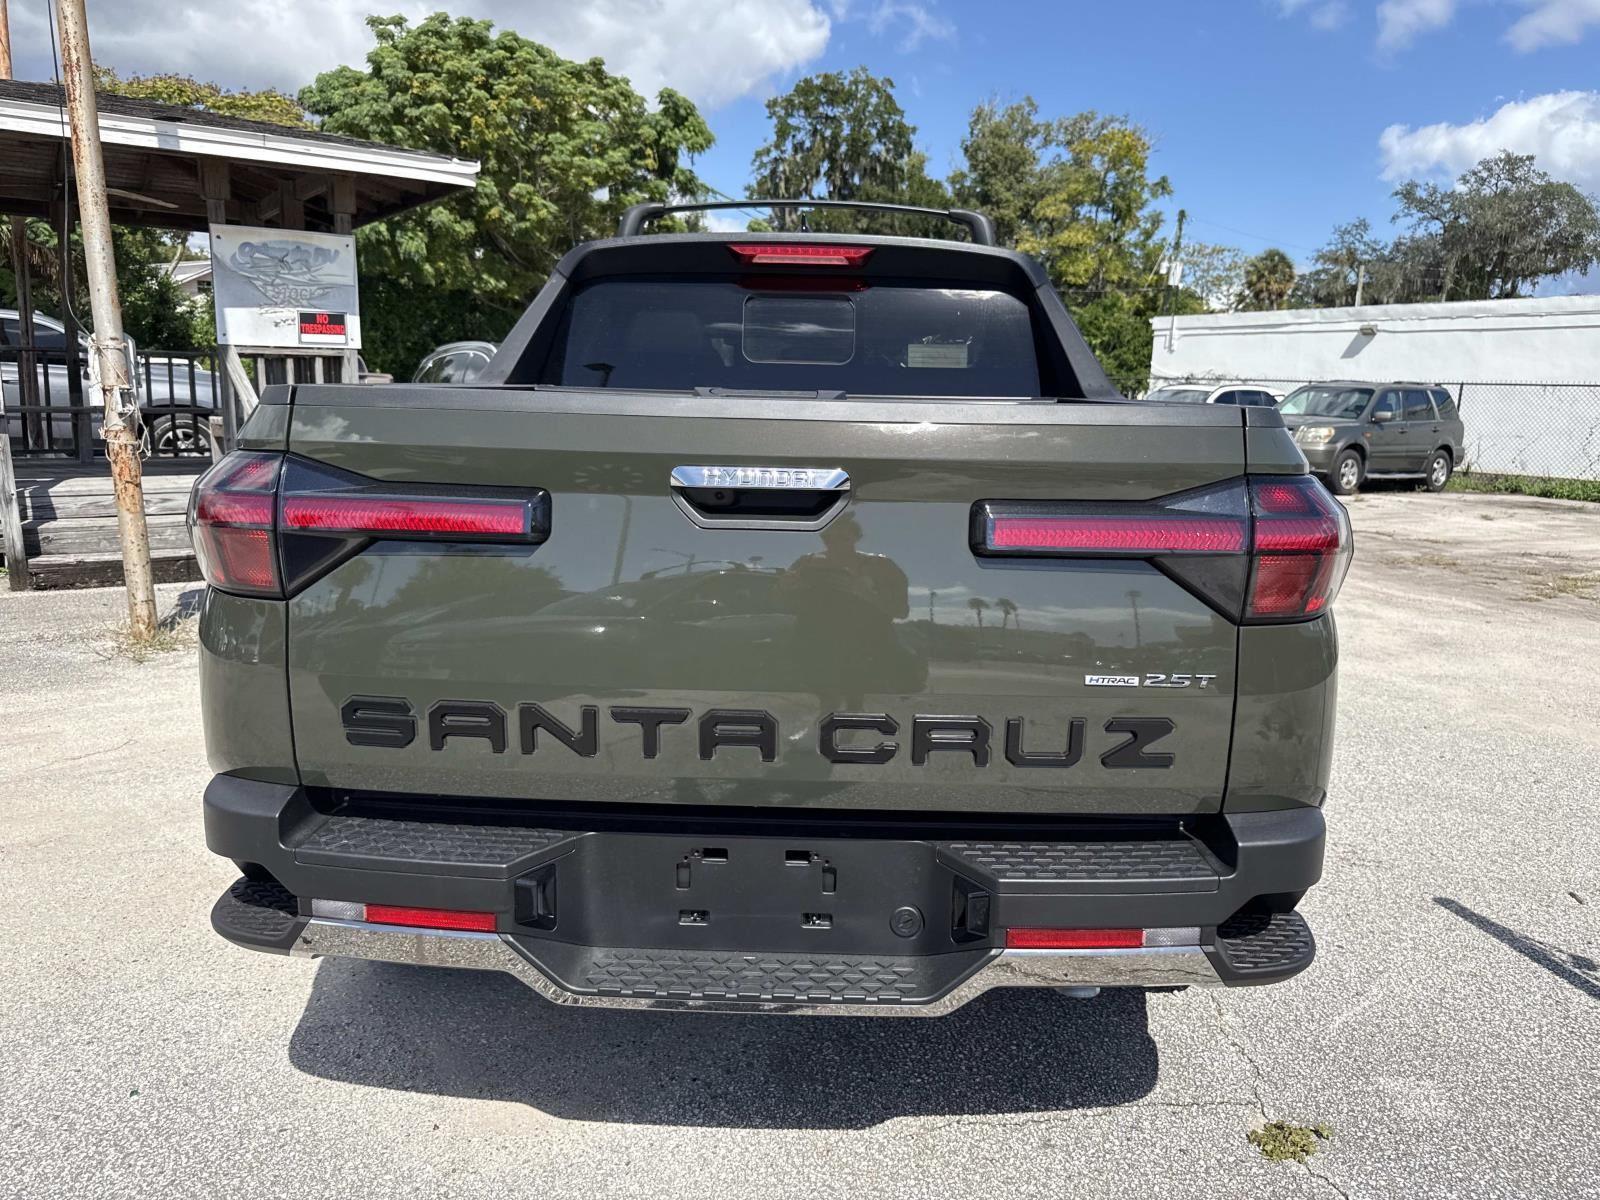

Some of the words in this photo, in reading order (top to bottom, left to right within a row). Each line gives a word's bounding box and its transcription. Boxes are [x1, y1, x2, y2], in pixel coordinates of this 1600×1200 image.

[316, 314, 329, 324] NO
[301, 323, 345, 335] TRESPASSING
[703, 468, 816, 488] HYUNDAI
[1088, 676, 1136, 686] HTRAC
[341, 694, 779, 763] SANTA
[818, 712, 1175, 769] CRUZ
